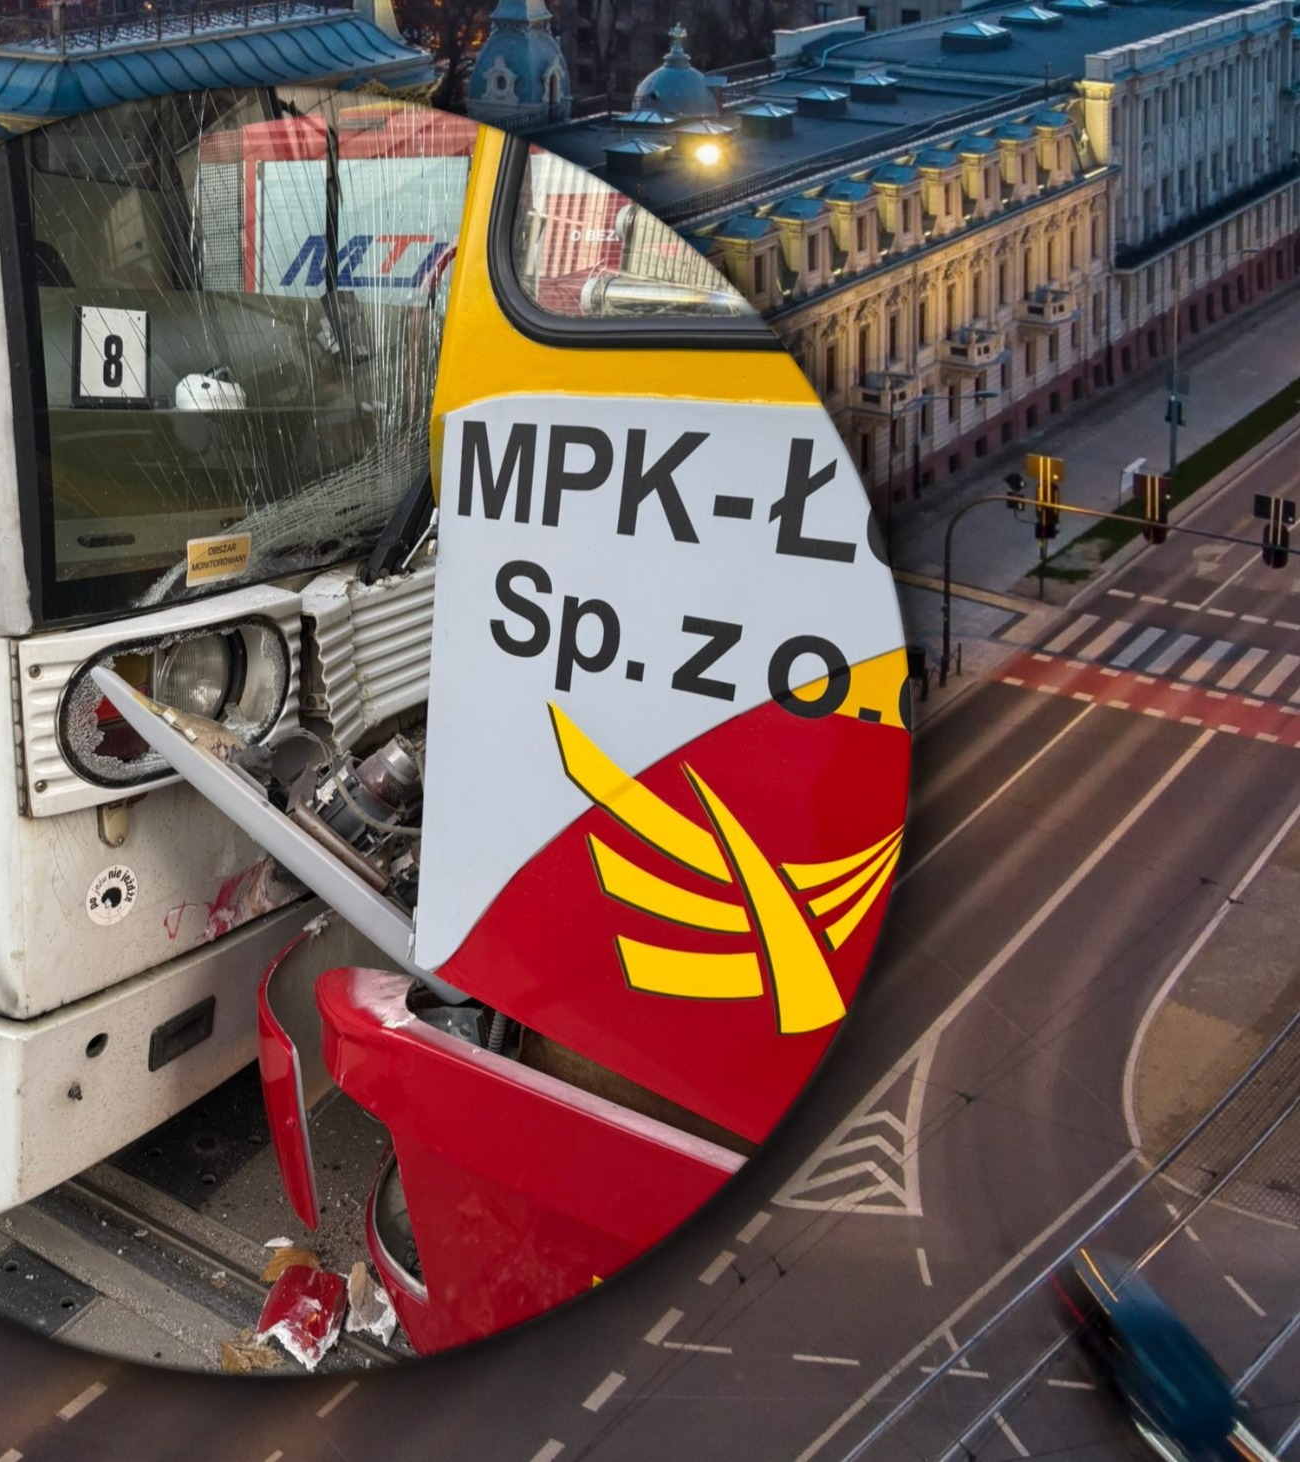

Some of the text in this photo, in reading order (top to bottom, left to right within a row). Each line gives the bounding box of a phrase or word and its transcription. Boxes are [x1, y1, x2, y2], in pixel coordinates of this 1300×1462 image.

[103, 334, 123, 388] 8
[191, 554, 247, 572] MONITOROWANY
[207, 543, 237, 556] OBSZAR
[490, 560, 912, 734] Sp. z o.
[90, 897, 99, 910] po
[108, 866, 122, 879] nie
